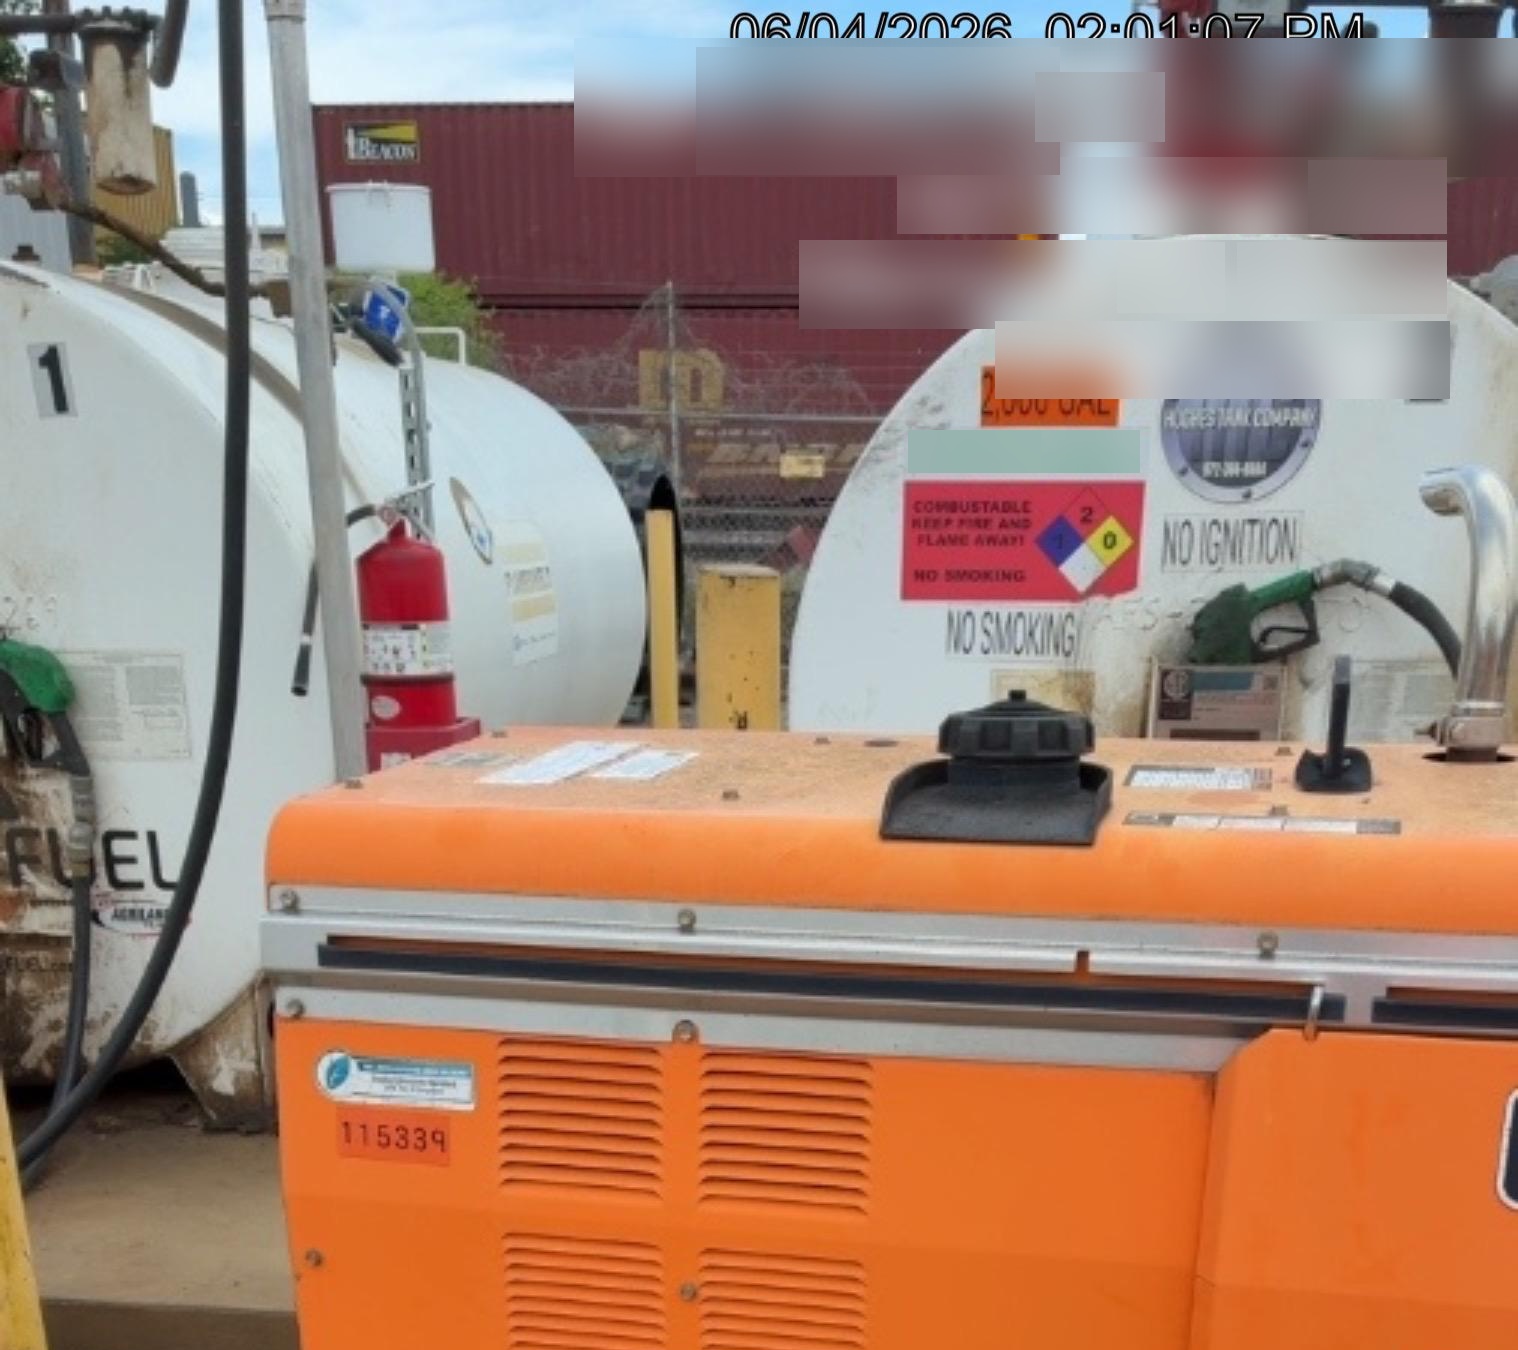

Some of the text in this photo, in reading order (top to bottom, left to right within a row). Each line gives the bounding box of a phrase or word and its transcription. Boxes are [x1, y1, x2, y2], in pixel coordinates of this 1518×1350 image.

[38, 344, 69, 414] 1
[913, 500, 1032, 514] COMBUSTABLE
[1080, 506, 1094, 524] 2
[911, 518, 1032, 530] KEEP FIRE AND
[917, 534, 969, 547] FLAME
[1103, 531, 1118, 550] 0
[1162, 517, 1297, 566] NO IGNITION
[914, 569, 1026, 583] NO SMOKING
[947, 610, 1076, 658] NO SMOKING
[4, 828, 180, 890] FUEL
[110, 906, 169, 923] AGRILAN
[341, 1120, 447, 1153] 115339
